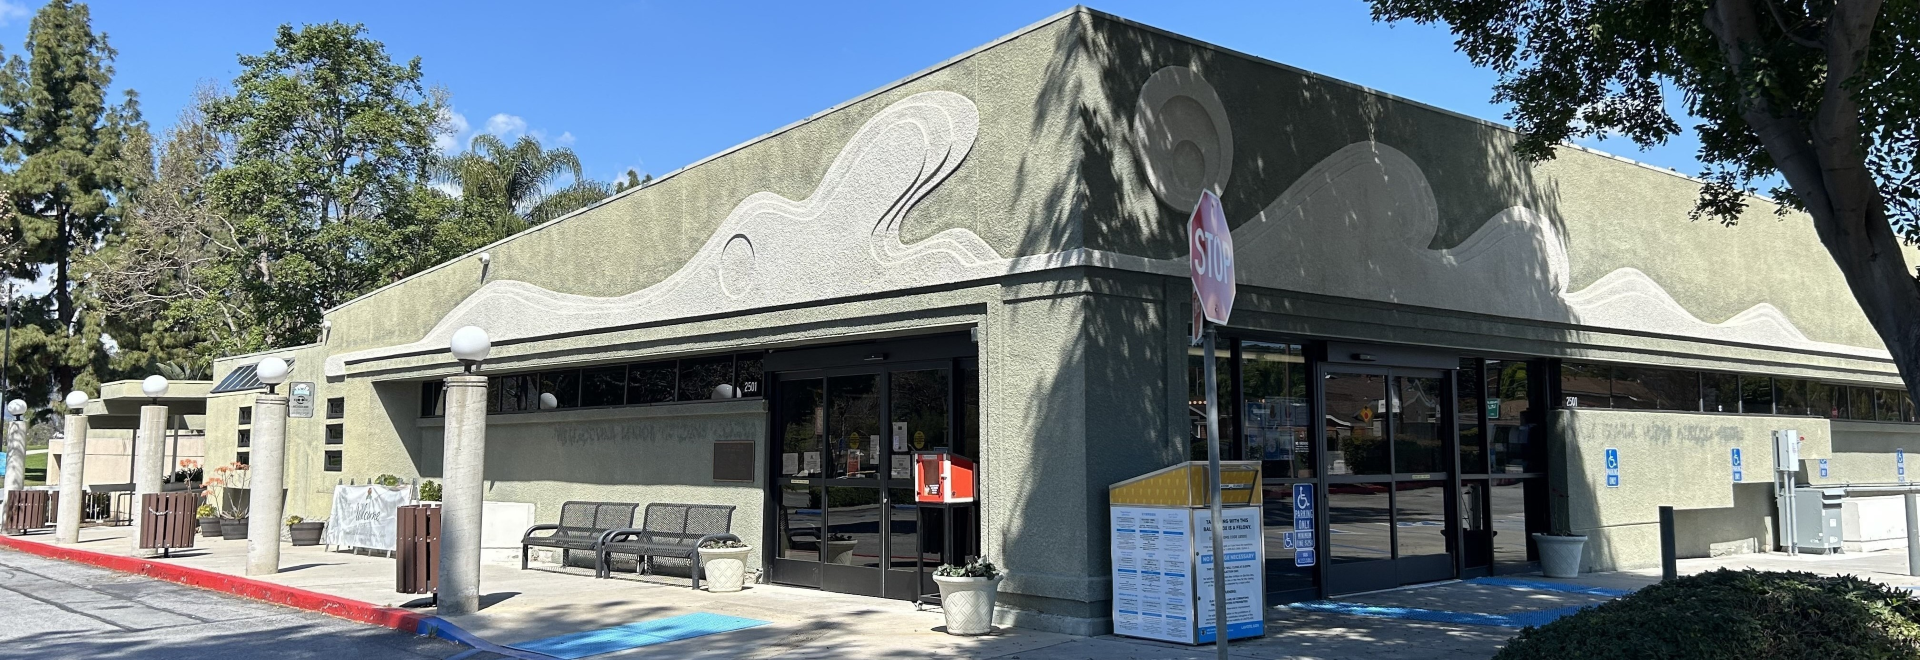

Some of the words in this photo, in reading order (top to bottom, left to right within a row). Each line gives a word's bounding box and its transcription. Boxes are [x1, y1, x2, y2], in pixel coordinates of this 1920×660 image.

[1195, 228, 1231, 284] STOP
[745, 382, 757, 392] 2501
[1566, 397, 1577, 407] 2501
[1295, 510, 1313, 519] PARKING
[1299, 520, 1310, 530] ONLY
